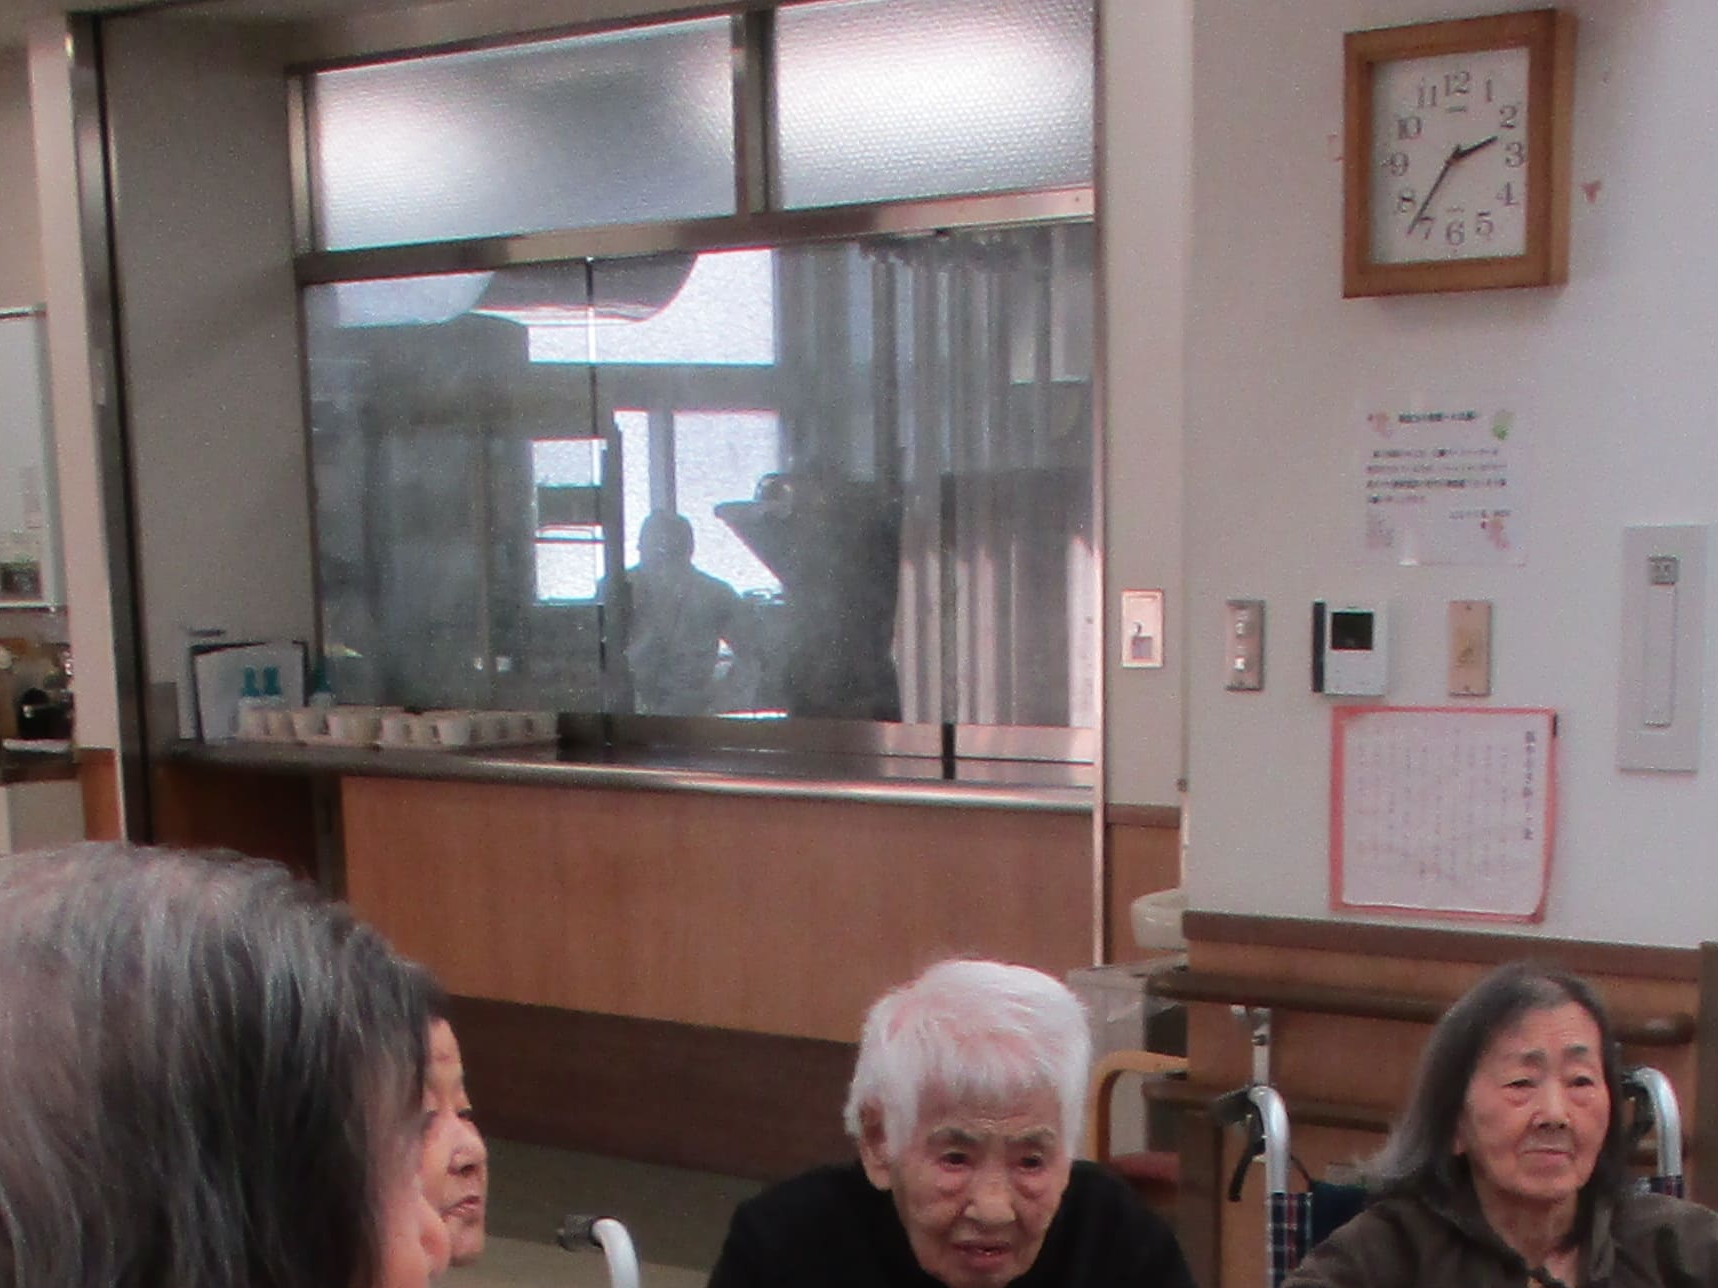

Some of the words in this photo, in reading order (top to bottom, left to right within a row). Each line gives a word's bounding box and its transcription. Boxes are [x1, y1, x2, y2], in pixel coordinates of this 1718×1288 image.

[1419, 82, 1437, 108] 11
[1443, 70, 1470, 96] 12
[1485, 78, 1493, 103] 1
[1398, 115, 1422, 140] 10
[1499, 105, 1518, 129] 2
[1389, 152, 1409, 177] 9
[1505, 141, 1525, 168] 3
[1396, 189, 1415, 214] 8
[1497, 182, 1518, 207] 4
[1419, 215, 1434, 241] 7
[1445, 221, 1465, 246] 6
[1475, 210, 1494, 237] 5
